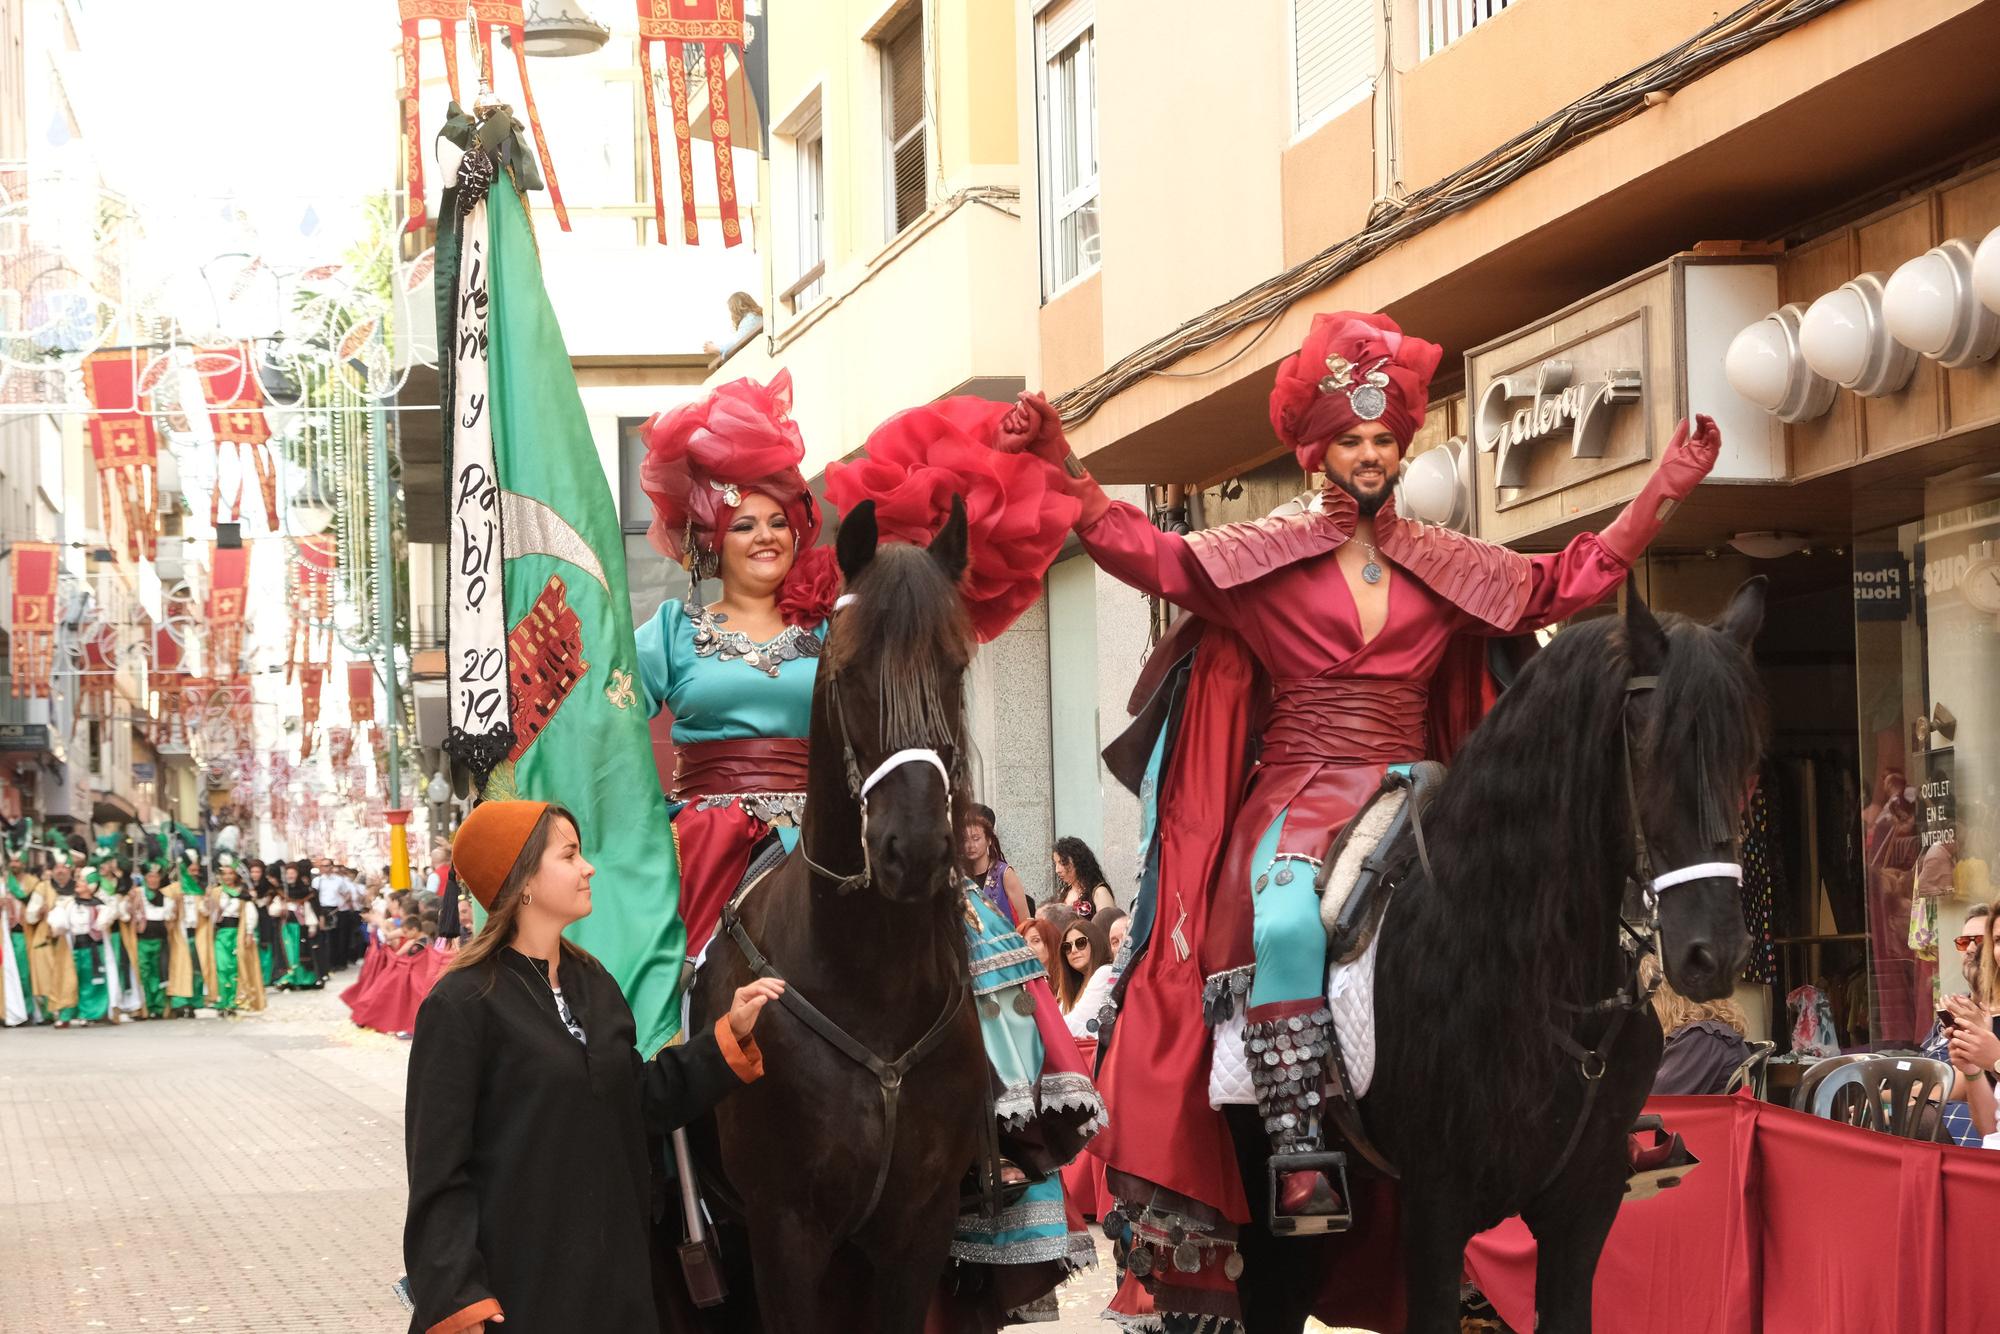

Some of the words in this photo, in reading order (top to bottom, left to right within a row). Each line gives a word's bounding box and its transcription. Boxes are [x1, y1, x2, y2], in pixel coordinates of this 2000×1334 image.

[462, 393, 485, 428] y
[459, 647, 503, 730] 2019
[1921, 780, 1950, 799] OUTLET
[1926, 806, 1937, 823] EN
[1938, 805, 1947, 821] EL
[1921, 828, 1955, 847] INTERIOR
